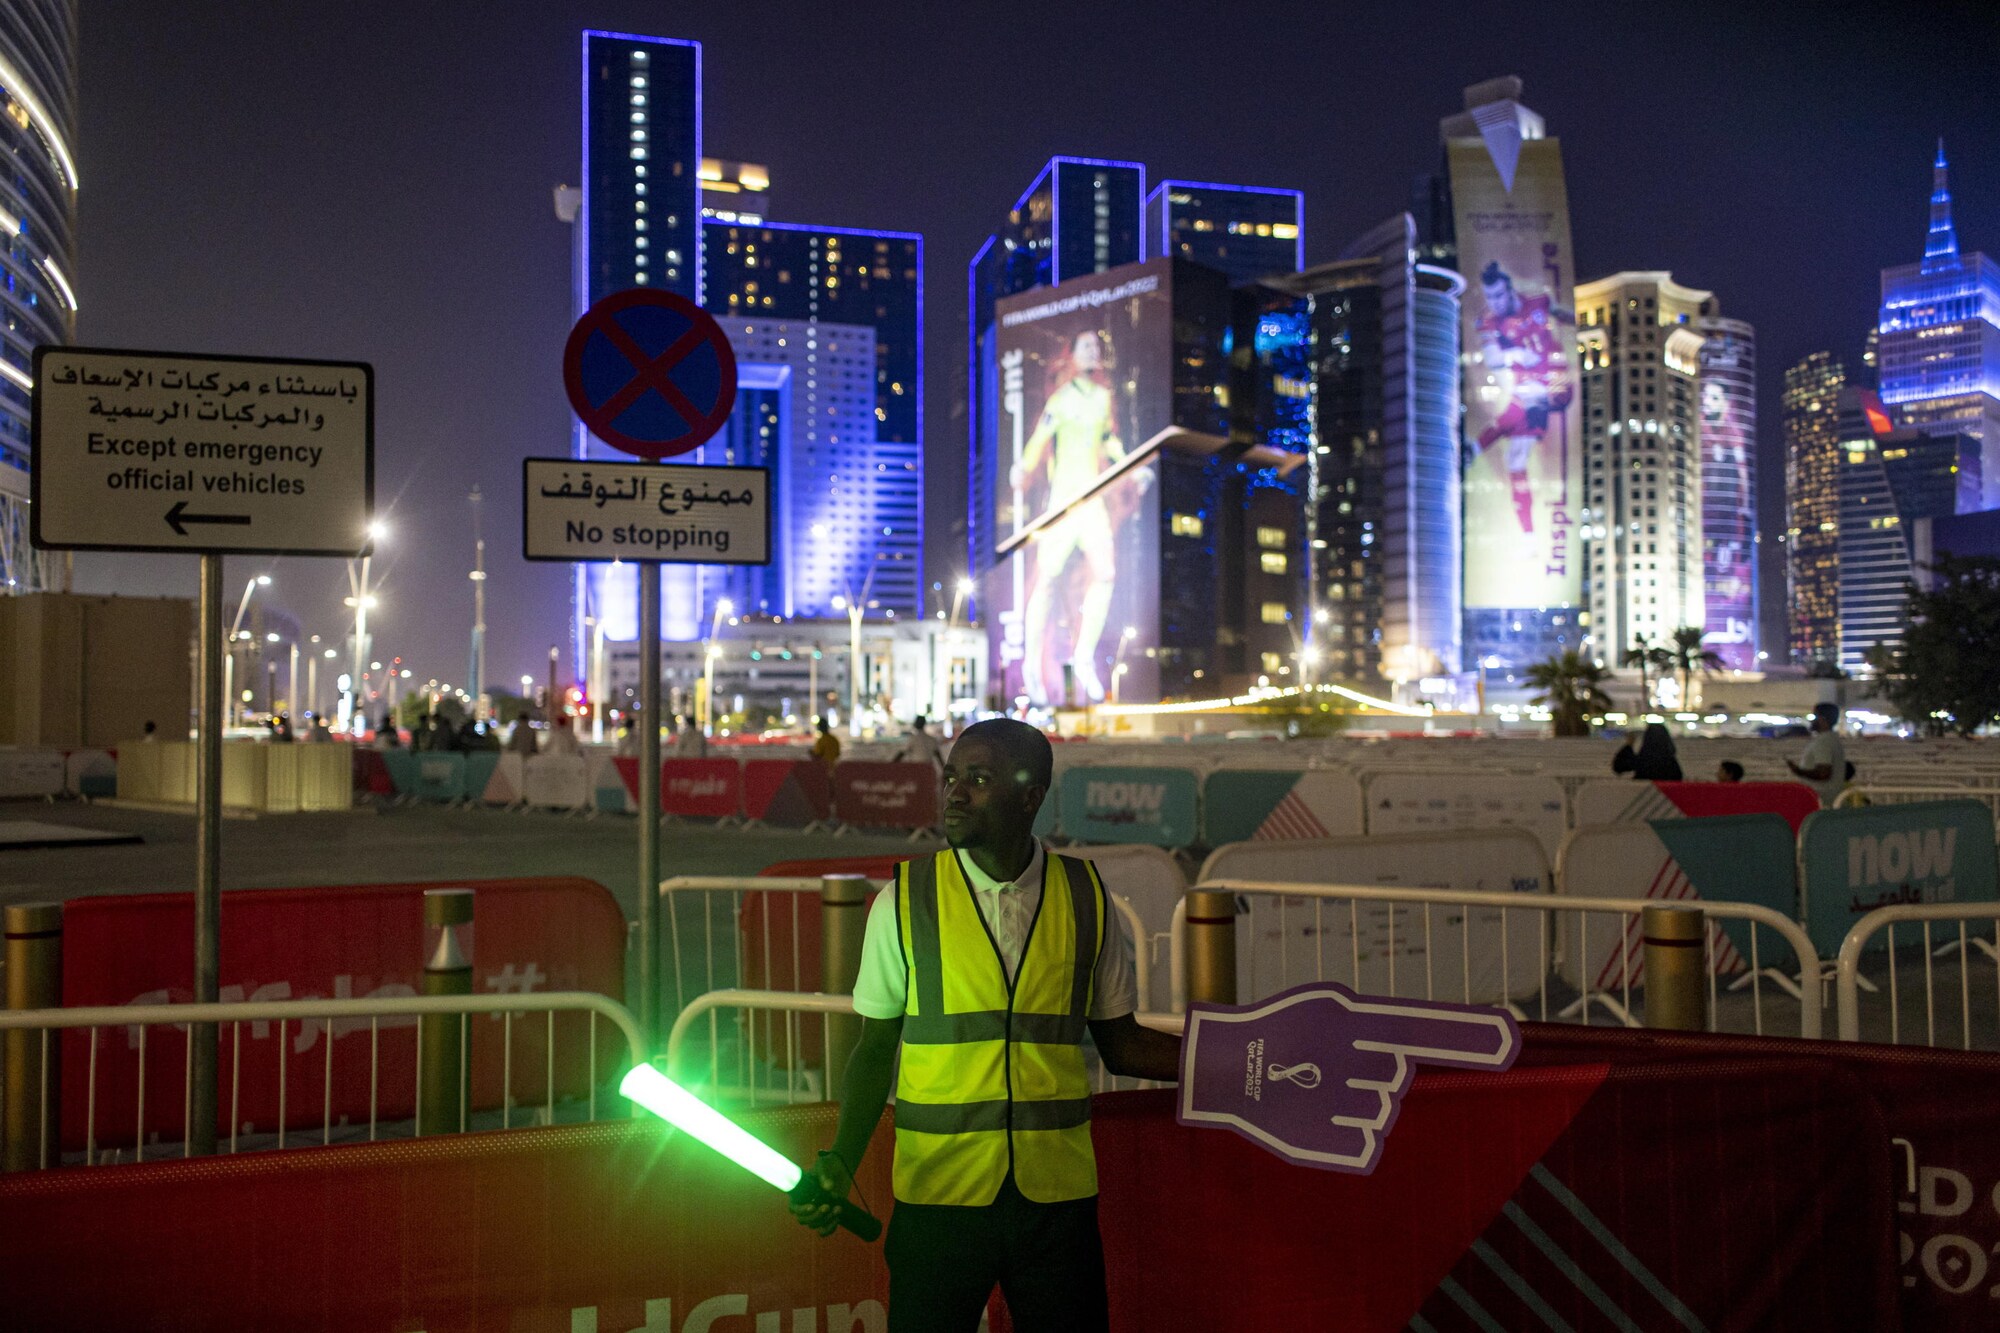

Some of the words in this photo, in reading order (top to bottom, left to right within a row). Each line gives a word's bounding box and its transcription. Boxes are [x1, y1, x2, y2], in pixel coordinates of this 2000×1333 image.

[160, 370, 250, 399] مركبات
[259, 375, 358, 404] باستثناء
[88, 396, 189, 424] الرسمية
[197, 402, 325, 431] والمركبات
[88, 433, 176, 461] Except
[184, 442, 323, 468] emergency
[107, 467, 194, 492] official
[202, 472, 305, 495] vehicles
[540, 472, 647, 508] التوقف
[658, 481, 753, 515] ممنوع
[566, 520, 603, 544] No
[612, 522, 730, 551] stopping
[1087, 781, 1166, 809] now
[1849, 826, 1957, 887] now
[1245, 1041, 1256, 1096] Qatar2022
[1255, 1057, 1264, 1085] WORLD
[1254, 1086, 1262, 1101] CUP
